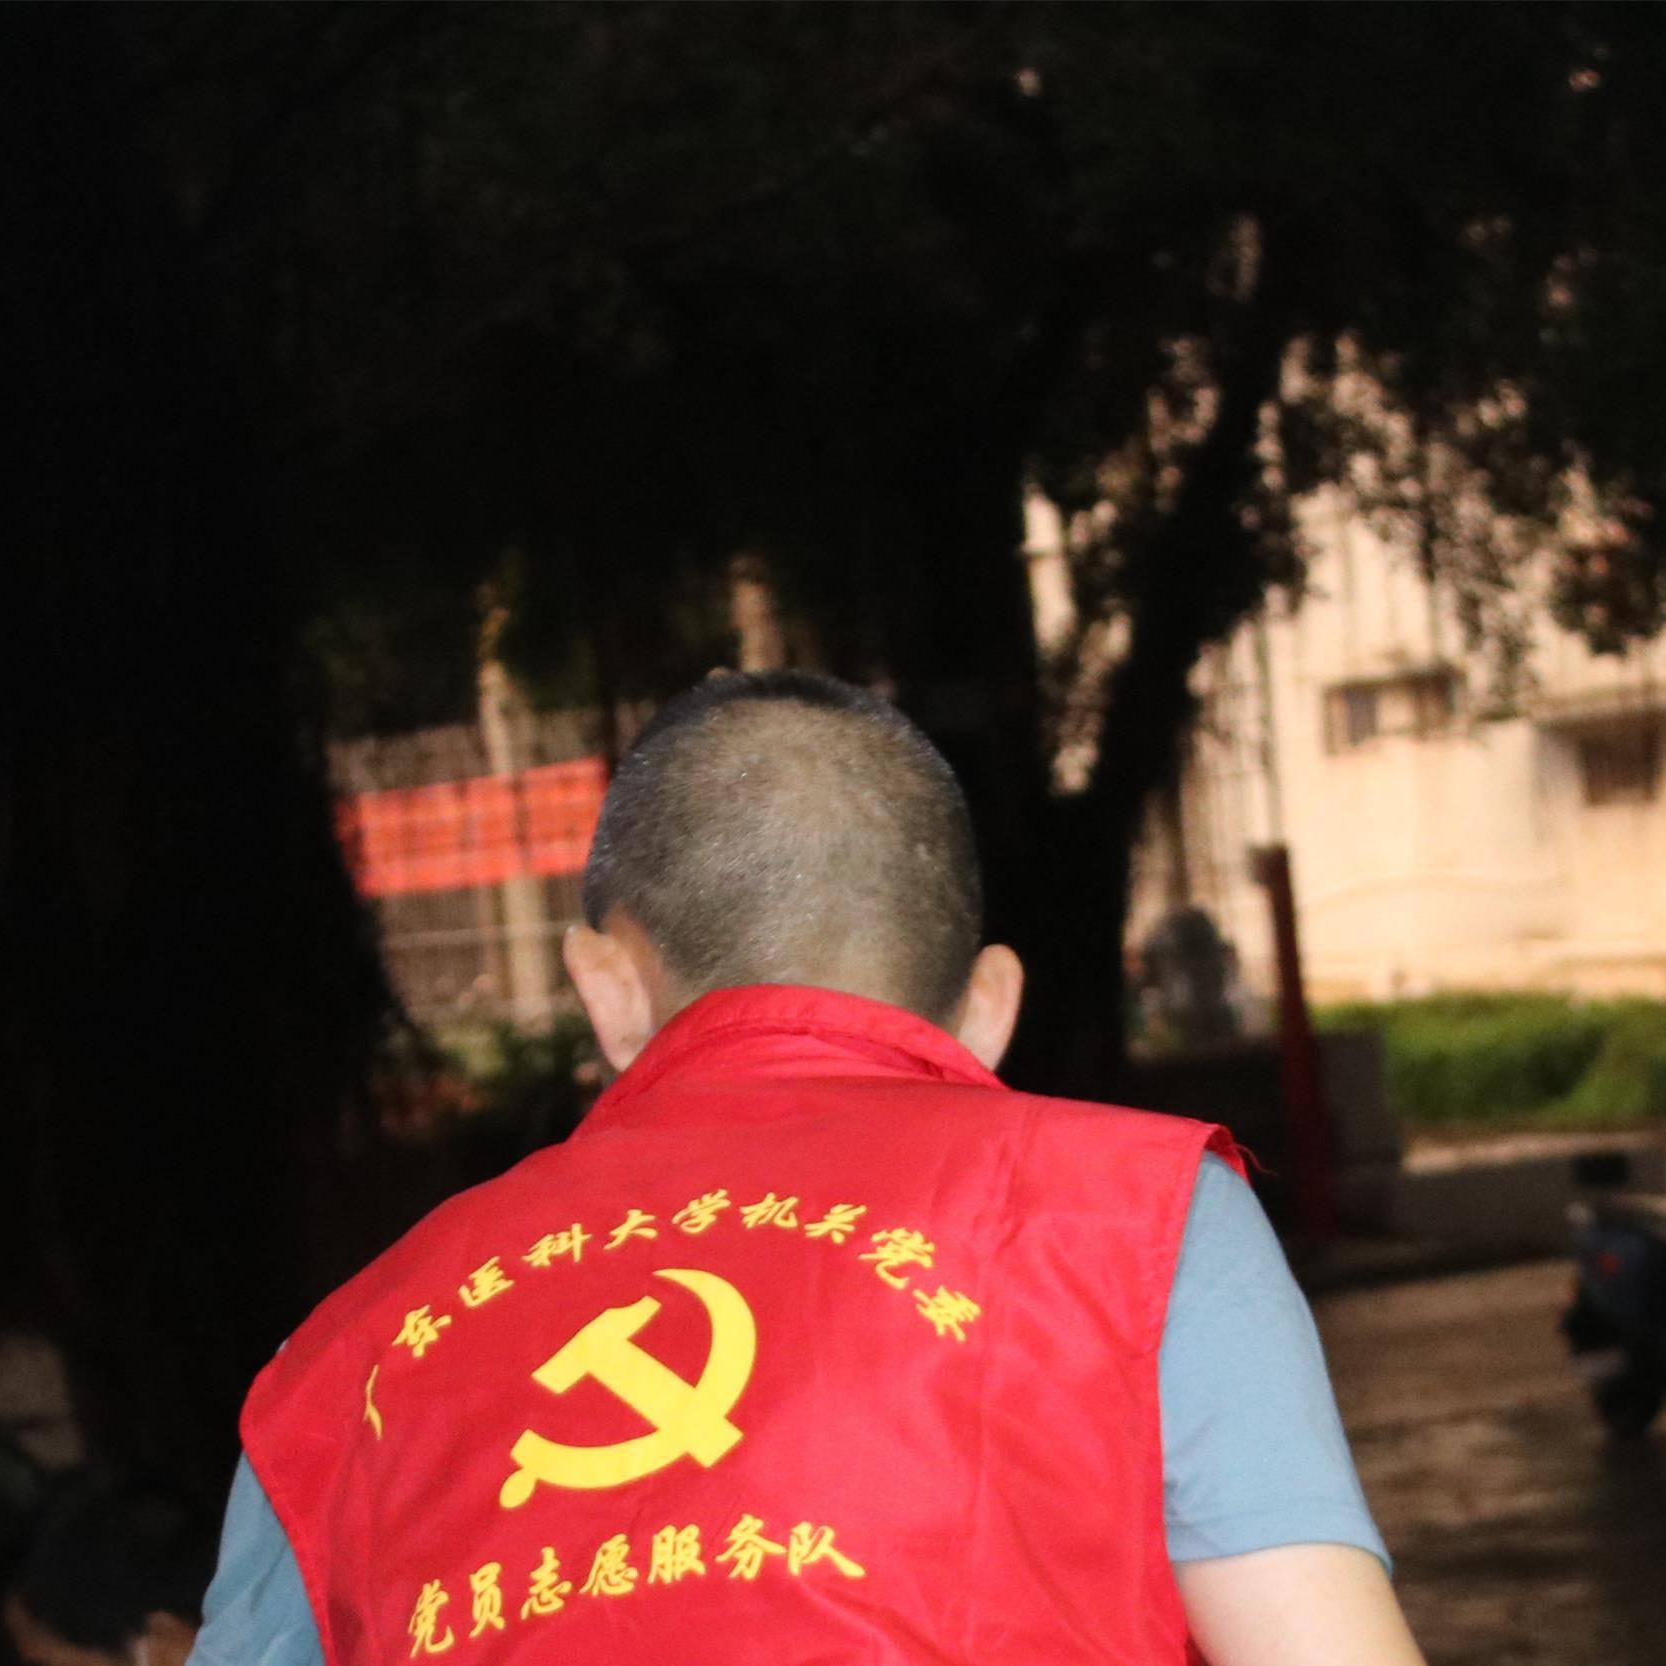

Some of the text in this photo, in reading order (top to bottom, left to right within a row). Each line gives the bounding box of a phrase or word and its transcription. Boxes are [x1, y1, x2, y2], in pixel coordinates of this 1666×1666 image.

[408, 1513, 866, 1659] 党员志愿服务队
